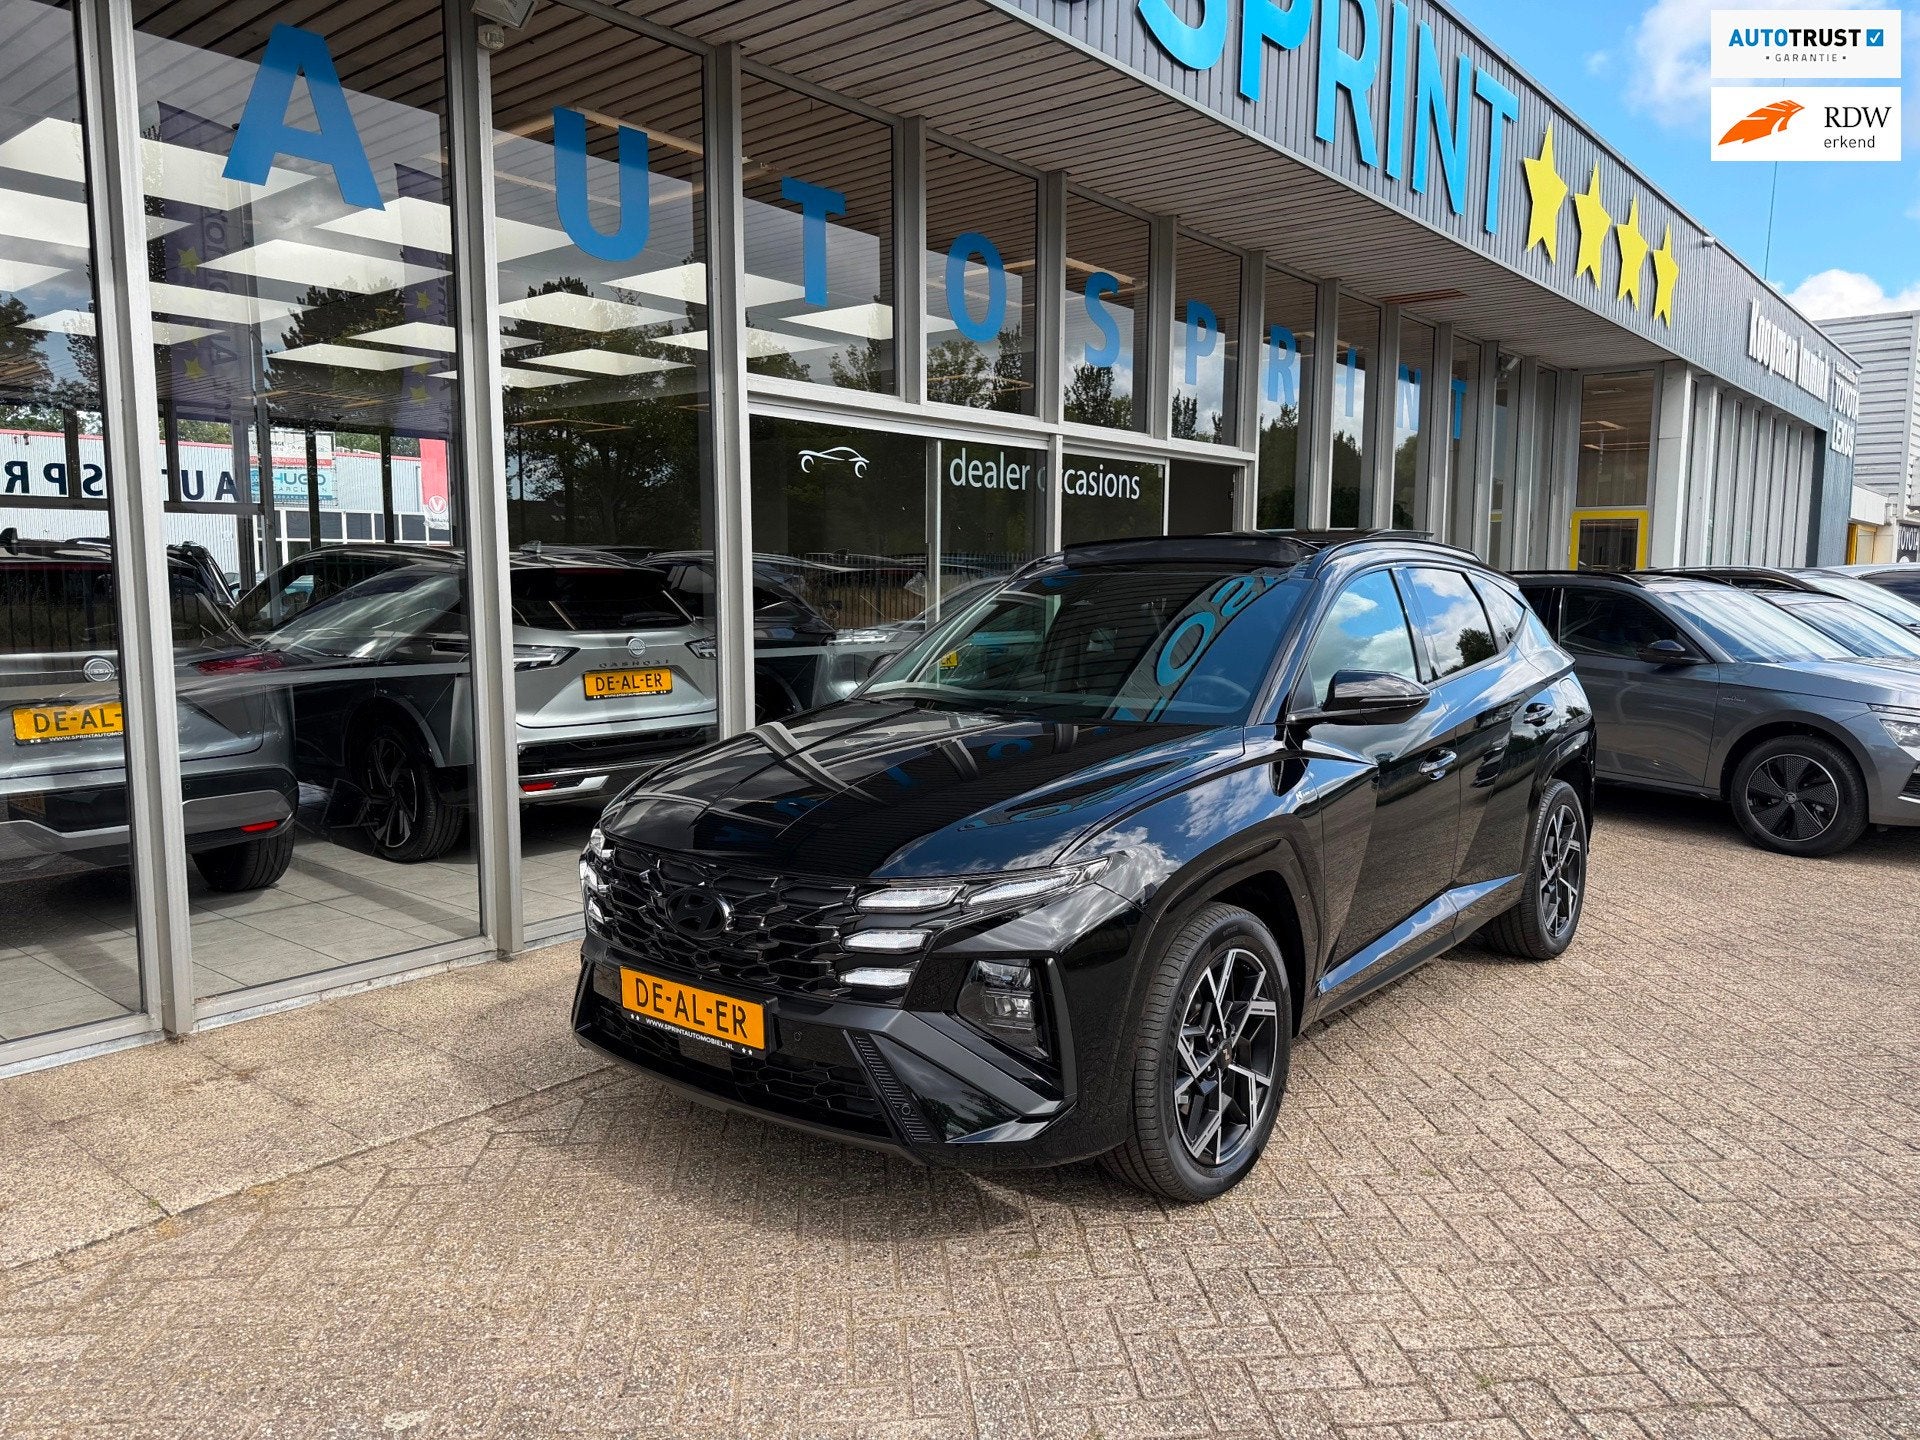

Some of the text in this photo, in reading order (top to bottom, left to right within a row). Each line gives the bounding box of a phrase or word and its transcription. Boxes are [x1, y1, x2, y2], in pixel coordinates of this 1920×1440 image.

[1748, 297, 1798, 384] Koopman
[1834, 376, 1860, 421] TOYOTA
[1831, 417, 1856, 458] LEXUS
[949, 447, 1141, 500] dealer ocasions
[595, 673, 663, 691] DE-AL-ER
[635, 976, 749, 1040] DE-AL-ER
[645, 1017, 736, 1052] WWW.SPRINTAUTOMOBIEL.NL
